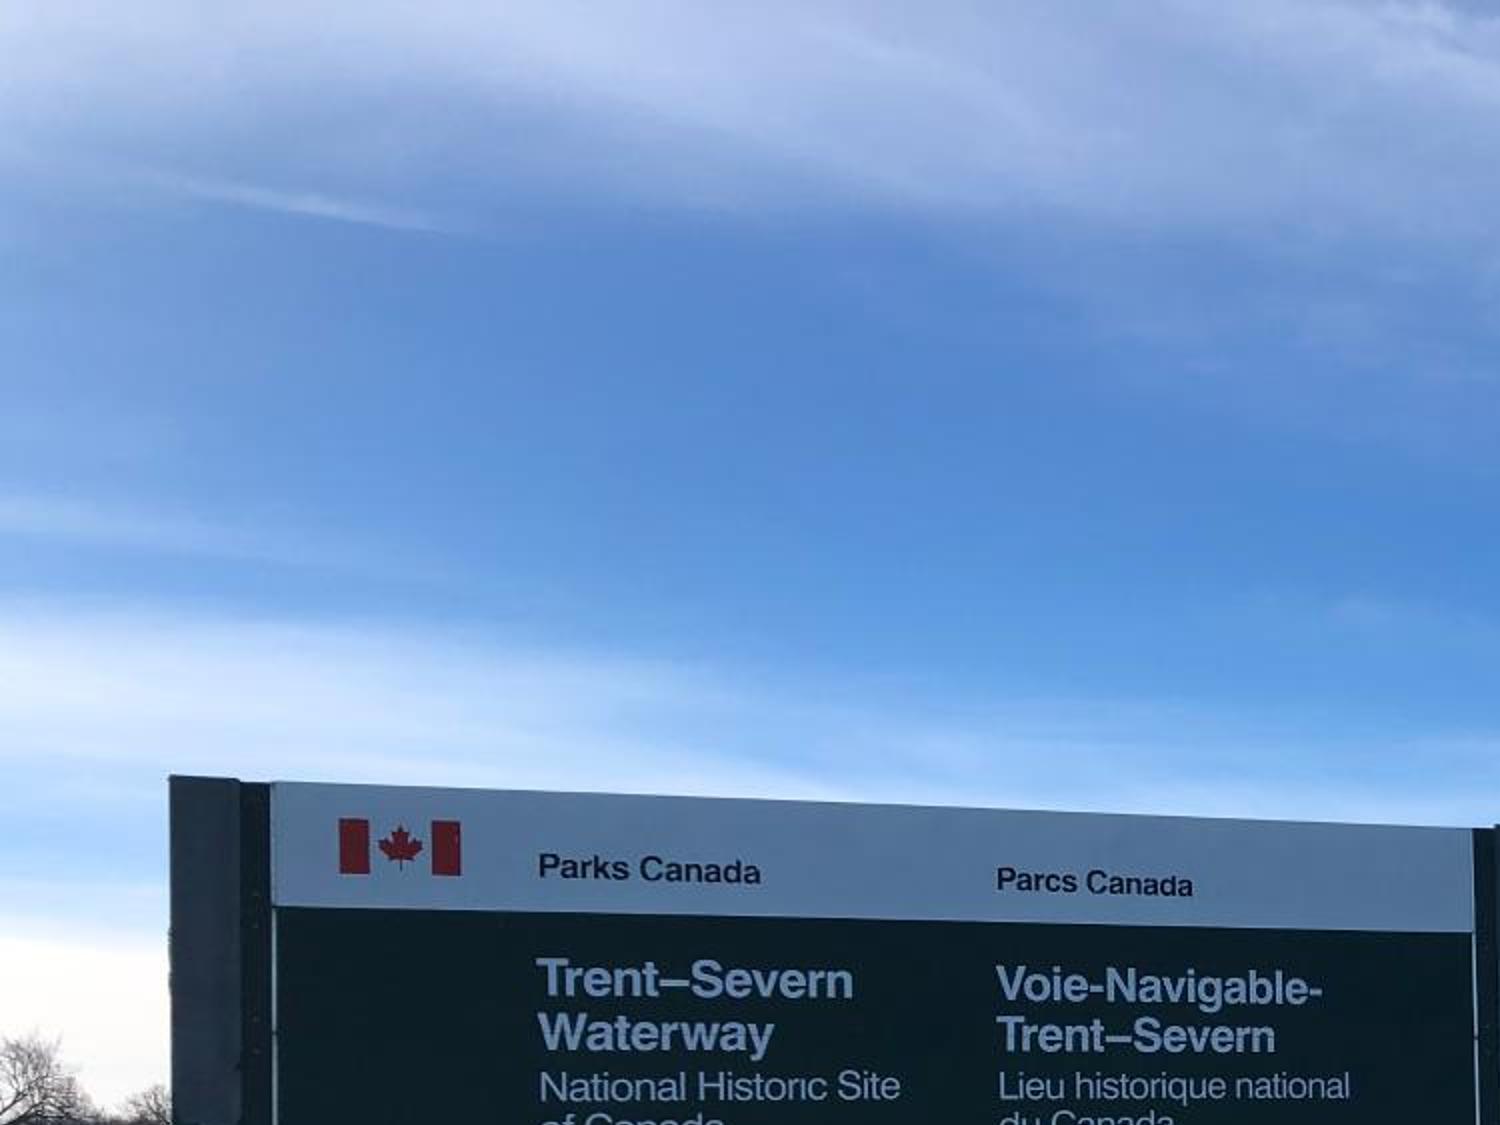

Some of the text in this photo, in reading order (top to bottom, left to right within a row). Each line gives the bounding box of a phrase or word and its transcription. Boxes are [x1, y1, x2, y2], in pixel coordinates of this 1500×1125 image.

[539, 853, 761, 885] Parks Canada
[997, 867, 1193, 897] Parcs Canada
[995, 965, 1323, 1012] Voie-Navigable-
[537, 1012, 775, 1060] Waterway
[540, 1069, 901, 1103] National Historic Site
[999, 1071, 1350, 1107] Lieu historique national
